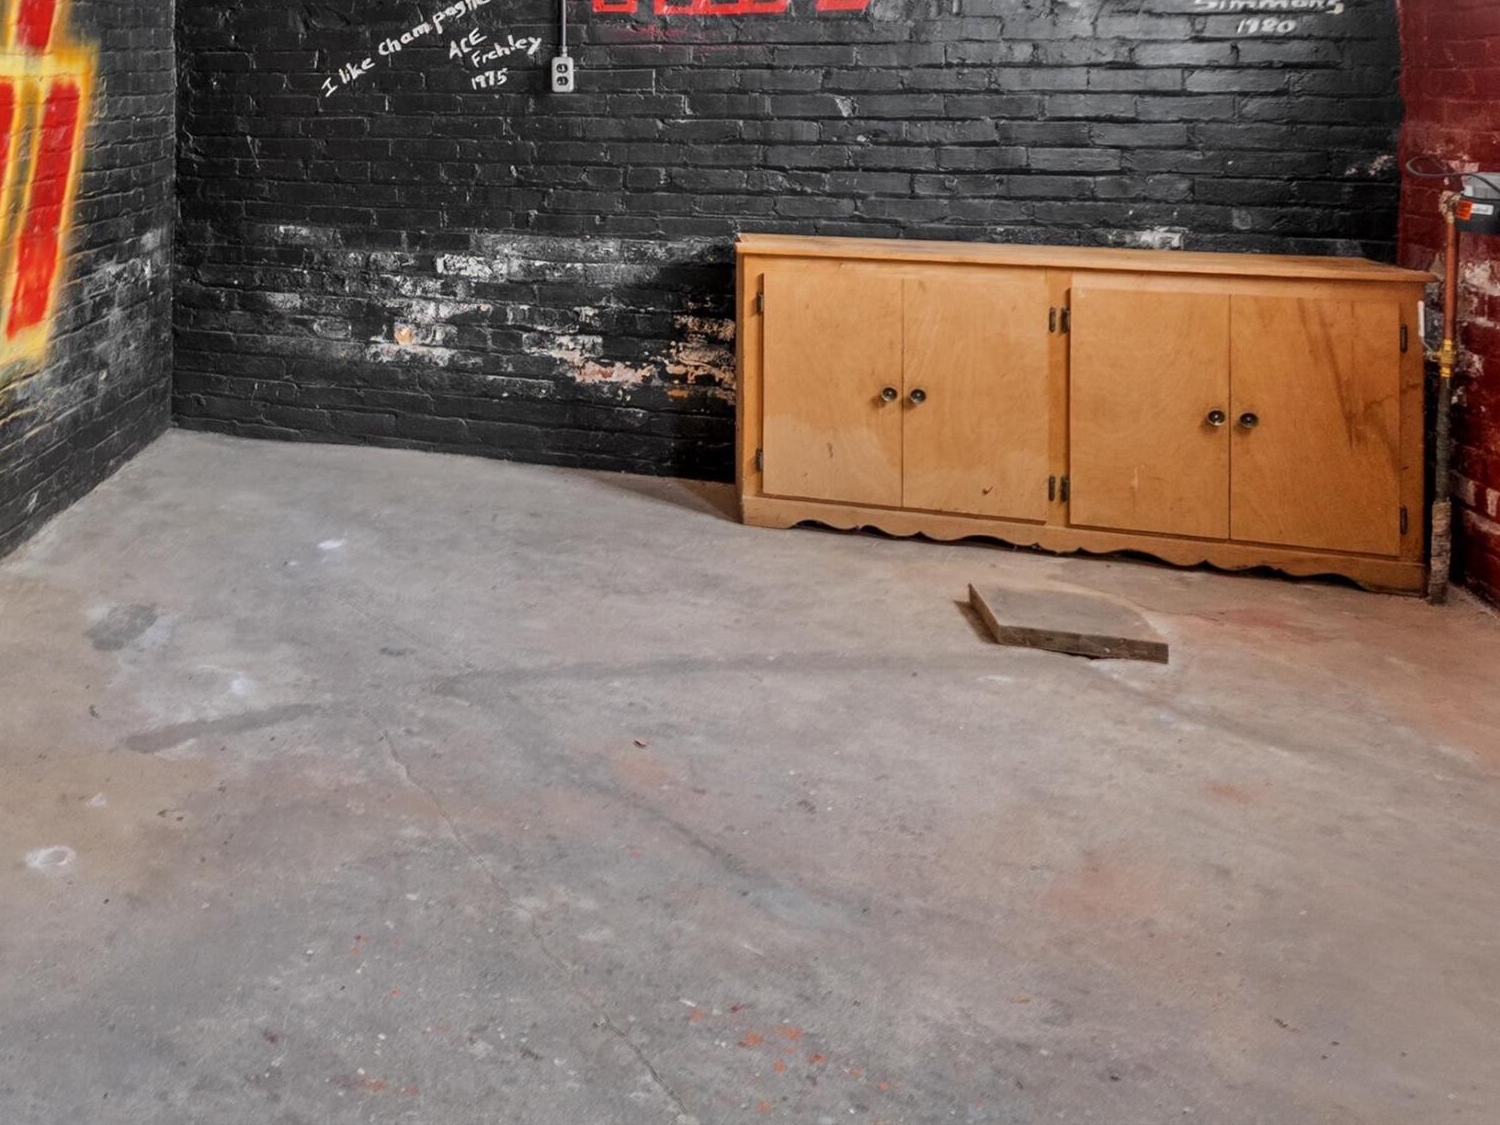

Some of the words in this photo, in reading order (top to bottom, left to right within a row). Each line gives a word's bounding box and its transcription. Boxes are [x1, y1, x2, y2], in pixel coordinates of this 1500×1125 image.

[448, 26, 488, 60] ACE
[320, 76, 339, 98] I
[338, 56, 376, 85] like
[470, 67, 509, 91] 1975
